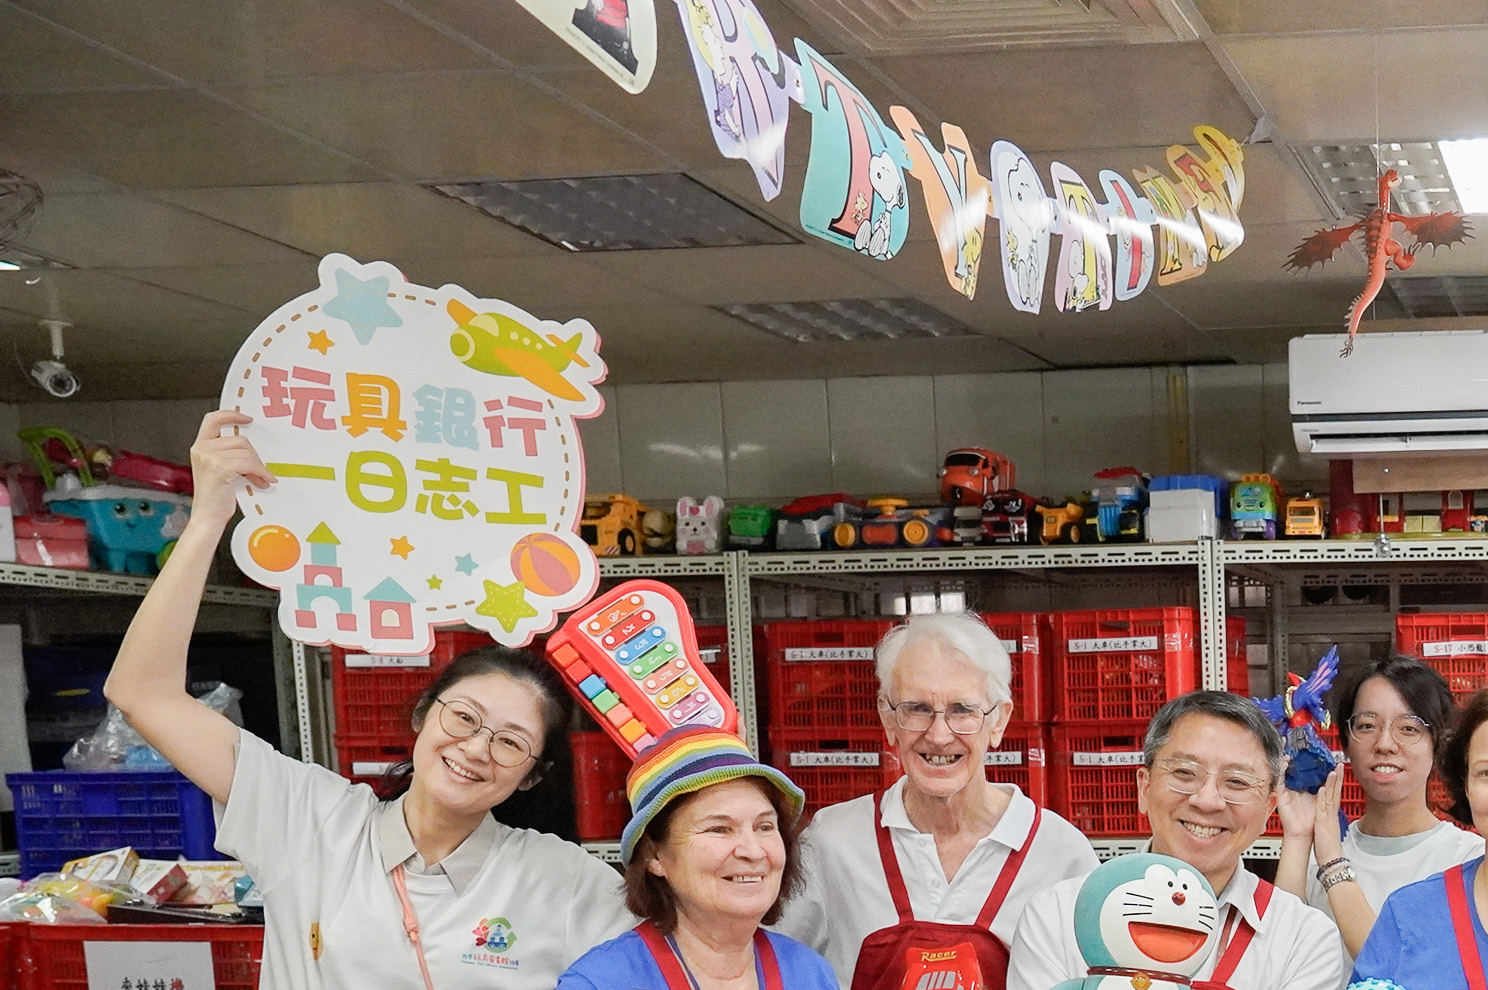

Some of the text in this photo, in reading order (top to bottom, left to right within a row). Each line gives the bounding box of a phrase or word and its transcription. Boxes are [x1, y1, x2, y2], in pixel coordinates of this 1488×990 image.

[261, 365, 546, 458] 玩具銀行
[264, 449, 548, 526] 一日志工
[921, 950, 957, 962] Racer
